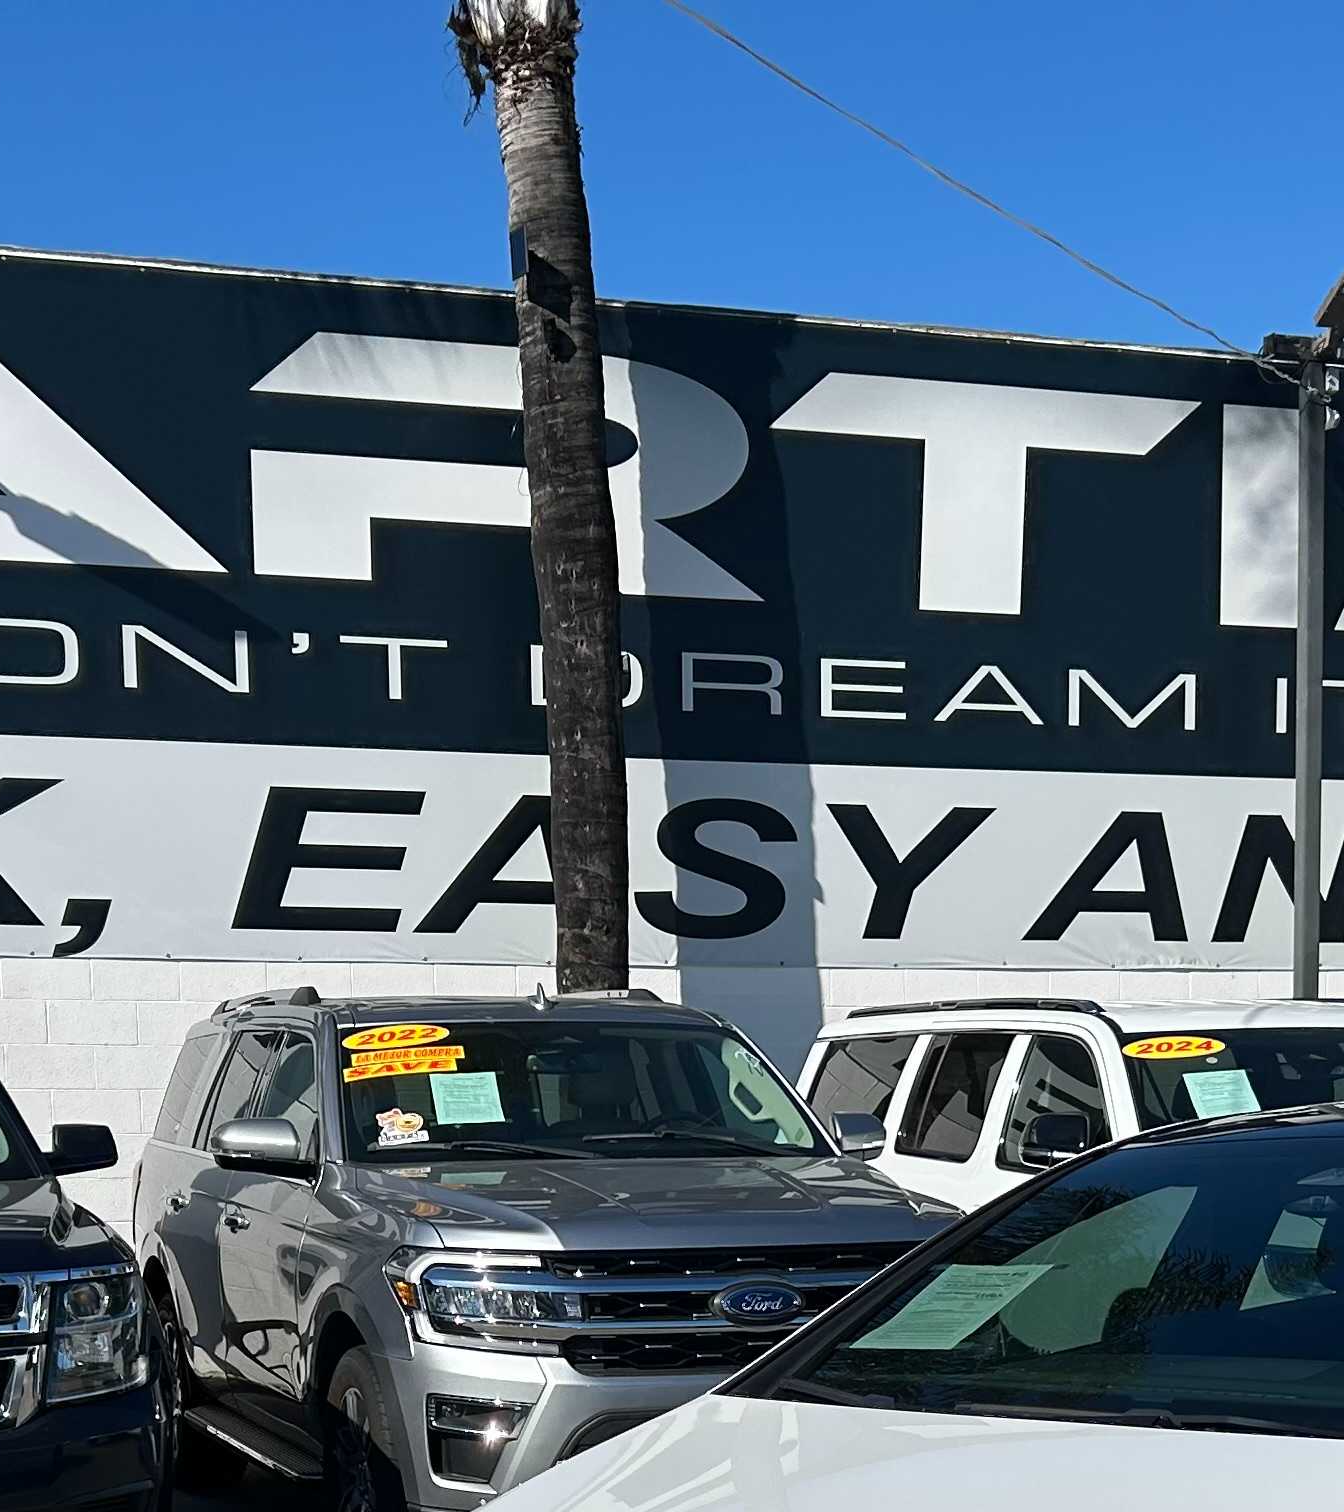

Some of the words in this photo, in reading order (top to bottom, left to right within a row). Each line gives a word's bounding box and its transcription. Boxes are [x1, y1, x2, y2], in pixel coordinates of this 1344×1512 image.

[232, 785, 997, 941] EASY
[357, 1027, 439, 1046] 2022
[1135, 1040, 1215, 1055] 2024
[346, 1060, 453, 1078] SAVE
[741, 1292, 783, 1311] Ford
